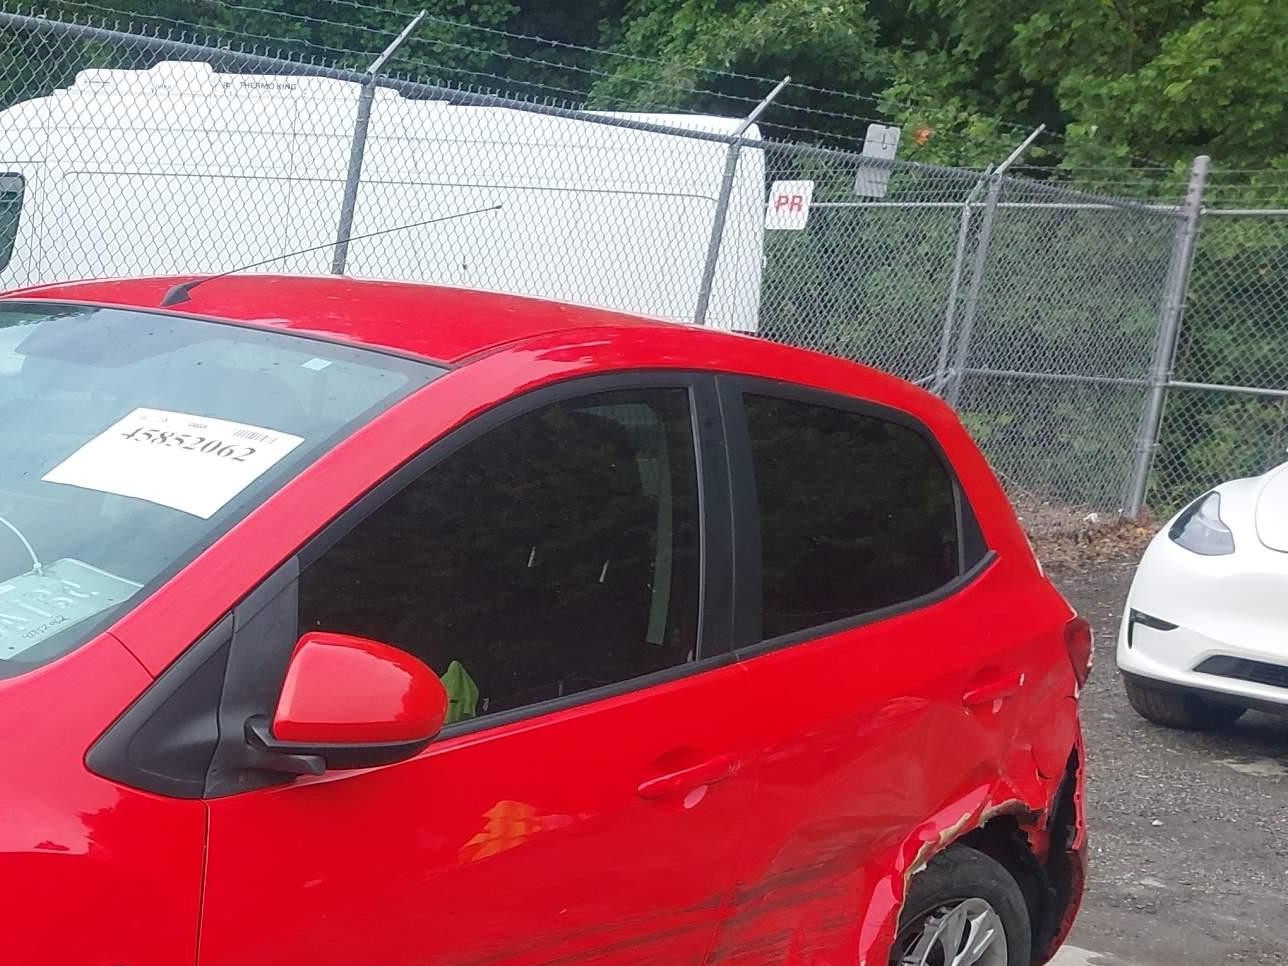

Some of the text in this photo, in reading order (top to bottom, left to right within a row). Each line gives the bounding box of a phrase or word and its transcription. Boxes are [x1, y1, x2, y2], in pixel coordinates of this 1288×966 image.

[240, 81, 274, 90] THERMO
[775, 195, 803, 213] PR
[121, 426, 256, 462] 45852062
